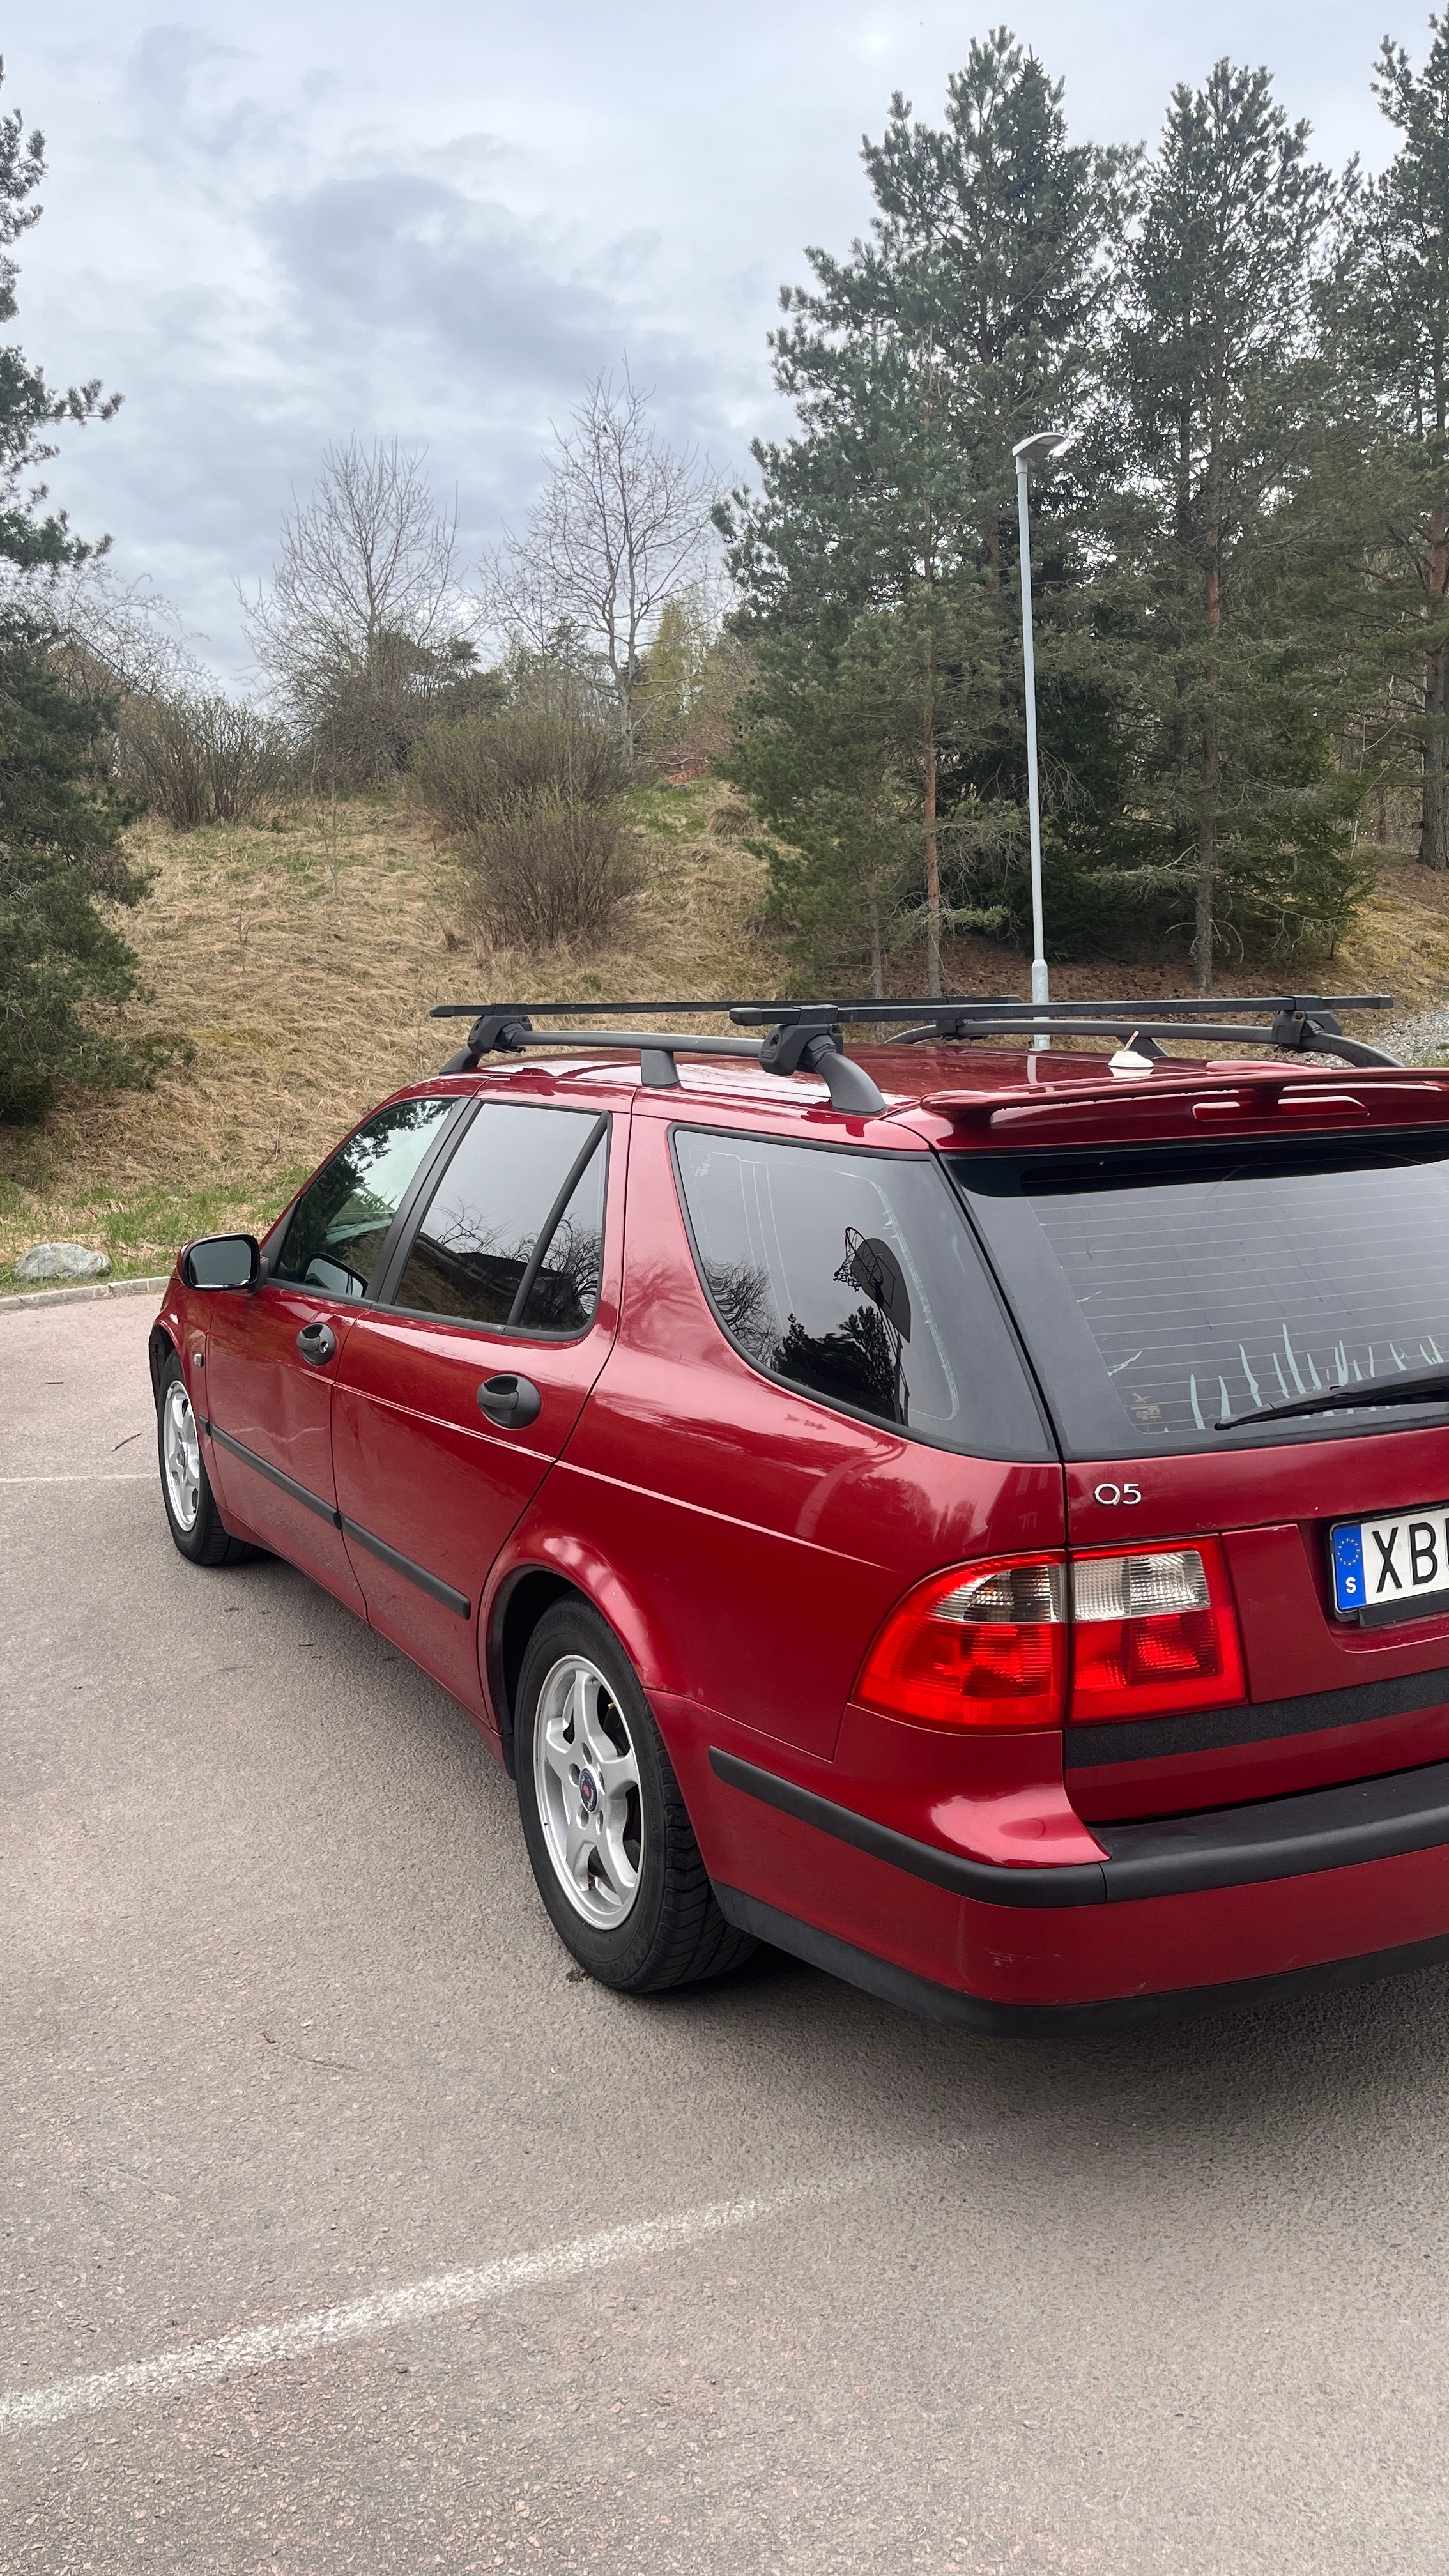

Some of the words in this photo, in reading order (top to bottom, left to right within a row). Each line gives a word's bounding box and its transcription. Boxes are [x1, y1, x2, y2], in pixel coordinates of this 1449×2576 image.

[1094, 1483, 1142, 1506] Q5
[1372, 1518, 1449, 1593] XB
[1346, 1576, 1356, 1594] S
